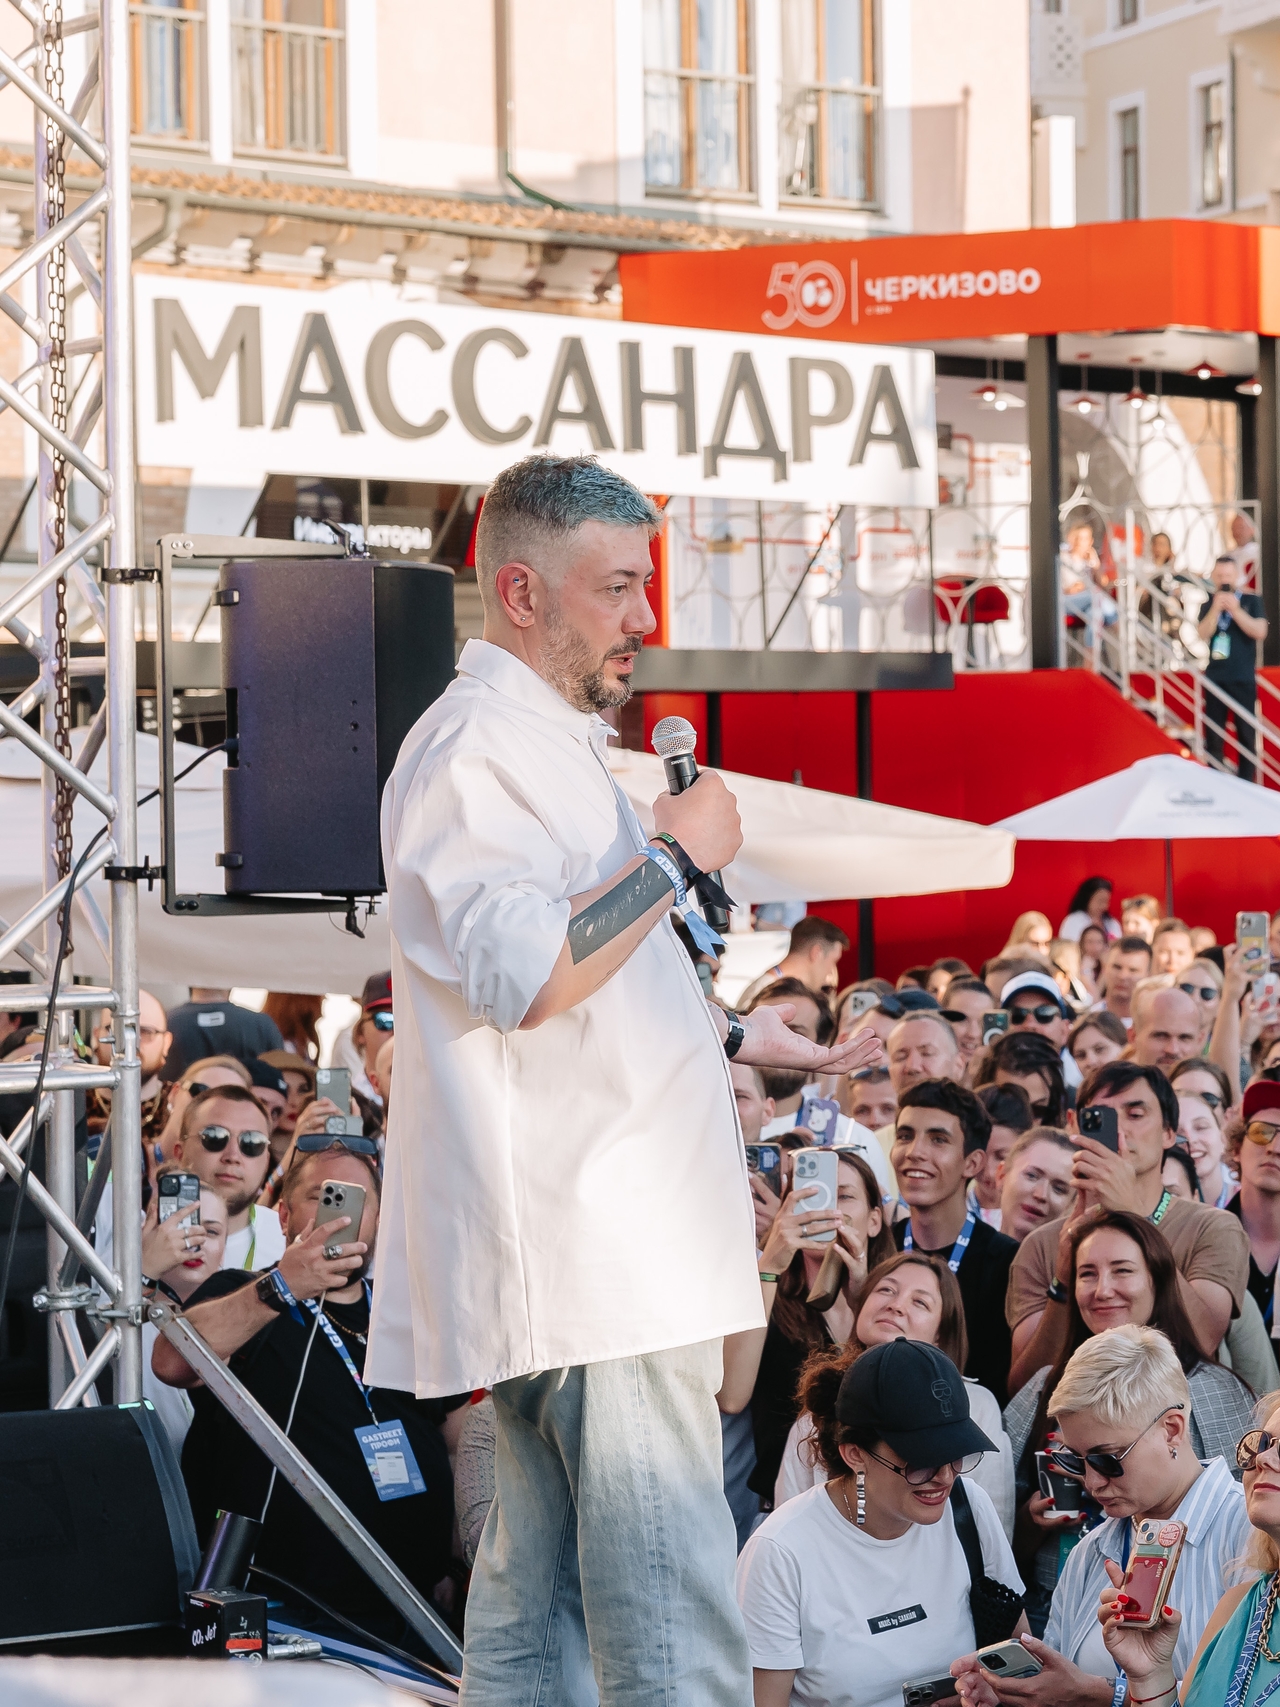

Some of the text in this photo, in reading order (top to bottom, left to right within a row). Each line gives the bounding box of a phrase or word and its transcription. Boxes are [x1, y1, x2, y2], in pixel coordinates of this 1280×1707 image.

[864, 267, 1041, 302] ЧЕРКИЗОВО
[152, 297, 920, 483] МАССАНДРА
[654, 855, 687, 905] СПИКЕР
[361, 1428, 403, 1444] GASTREET
[370, 1438, 401, 1451] ПРОФИ
